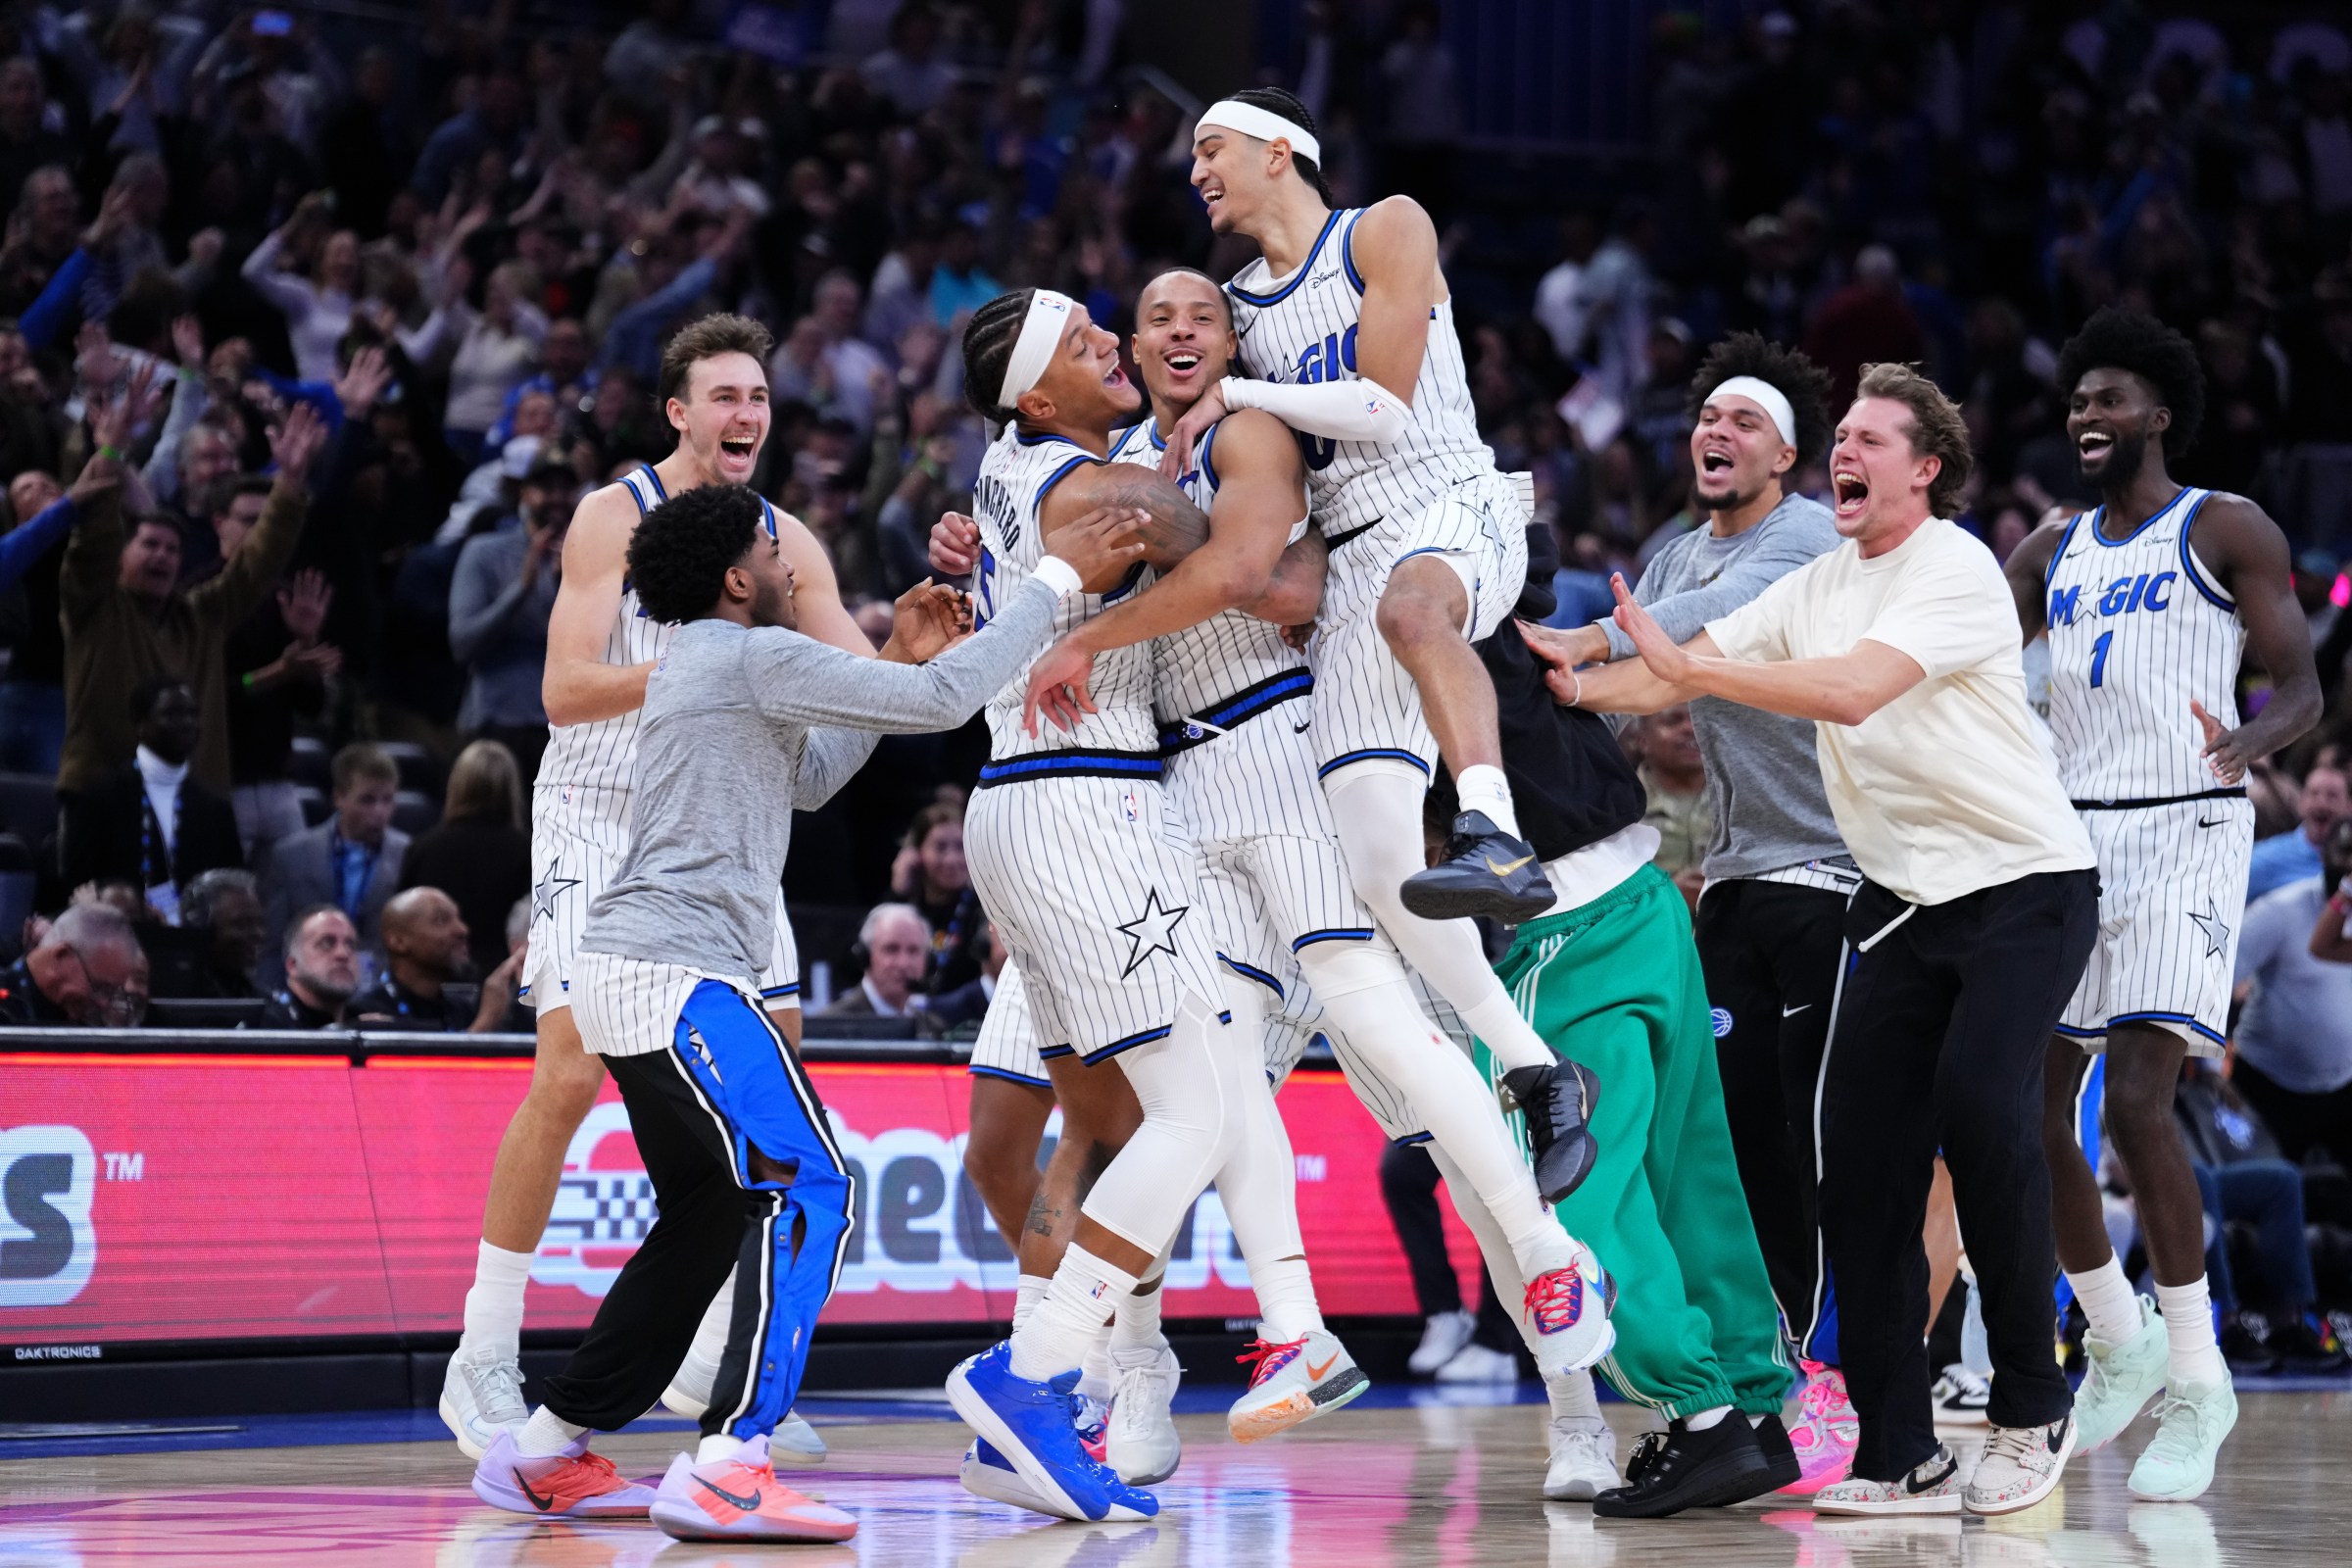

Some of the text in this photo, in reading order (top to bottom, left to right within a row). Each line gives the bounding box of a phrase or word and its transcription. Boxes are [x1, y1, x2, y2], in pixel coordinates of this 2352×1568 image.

[2089, 629, 2114, 689] 1
[103, 1152, 144, 1182] TM
[15, 1346, 102, 1360] DAKTRONICS
